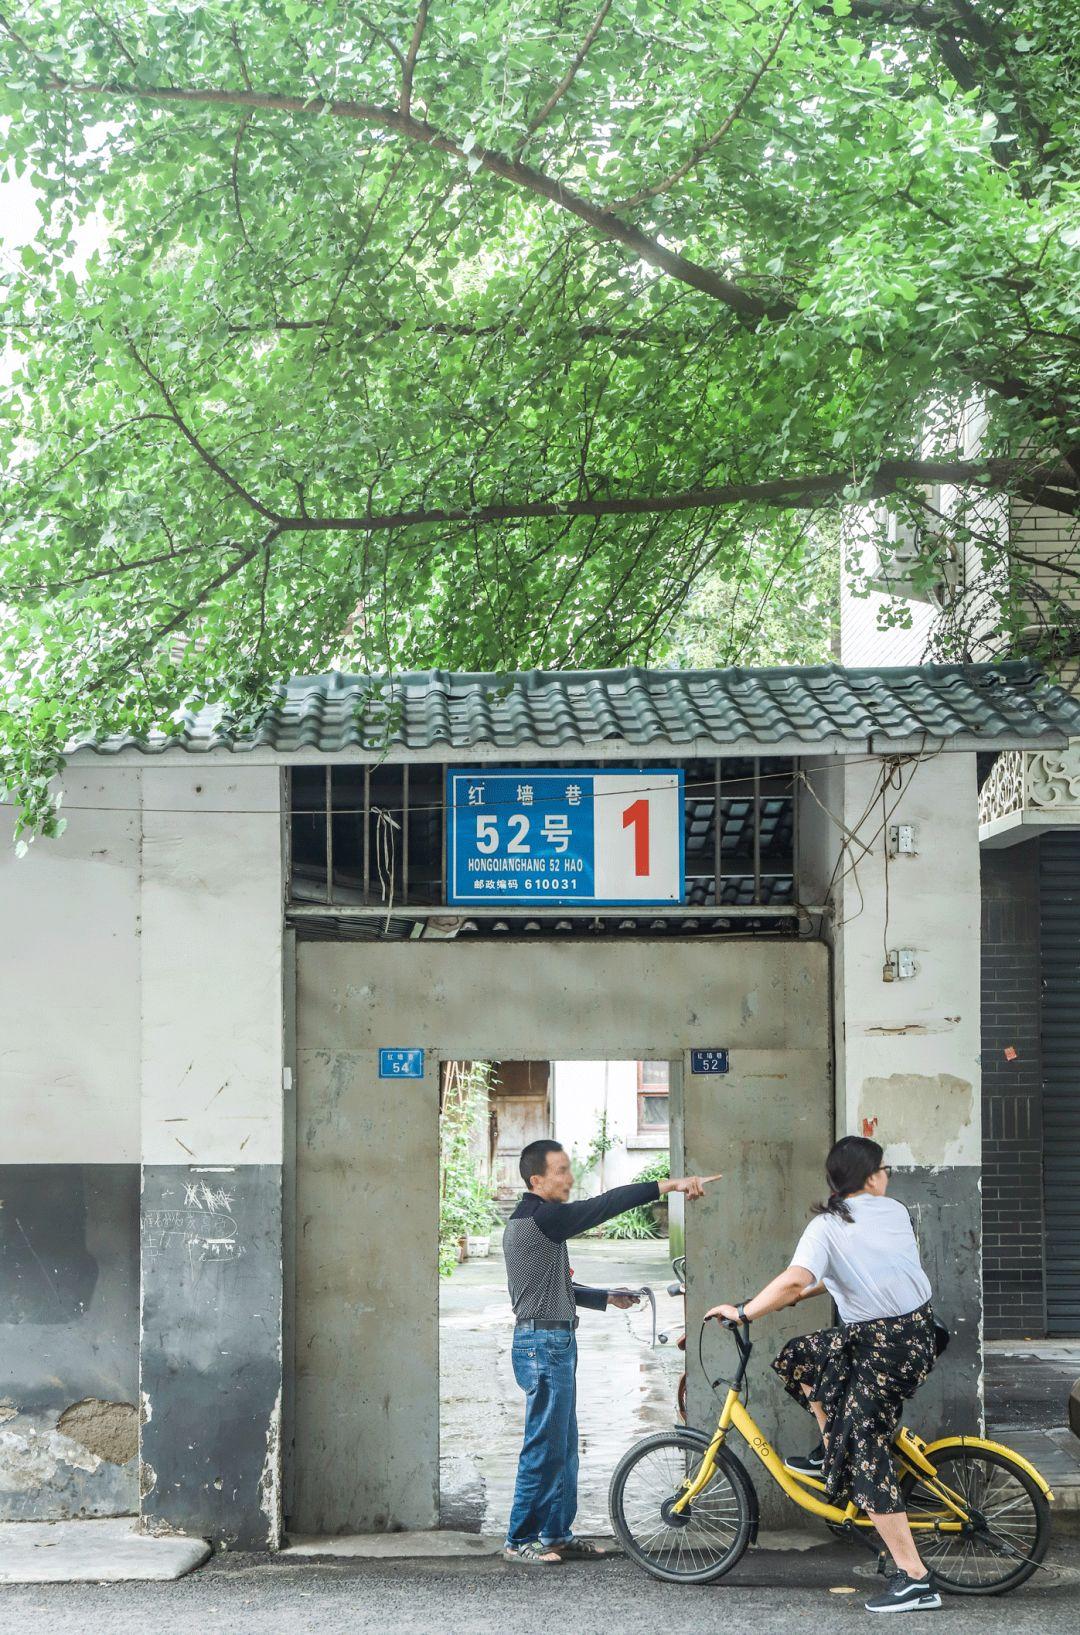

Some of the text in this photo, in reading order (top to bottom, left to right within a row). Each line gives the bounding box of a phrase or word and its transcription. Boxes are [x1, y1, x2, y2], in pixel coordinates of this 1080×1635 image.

[468, 784, 582, 806] 红墙巷
[476, 814, 573, 854] 52号
[622, 799, 650, 877] 1
[468, 858, 583, 873] HONGQIANGHANG 52 HAO
[474, 879, 577, 890] 邮政编码 610031
[392, 1062, 410, 1073] 54
[702, 1059, 719, 1071] 52
[753, 1438, 769, 1456] ofo
